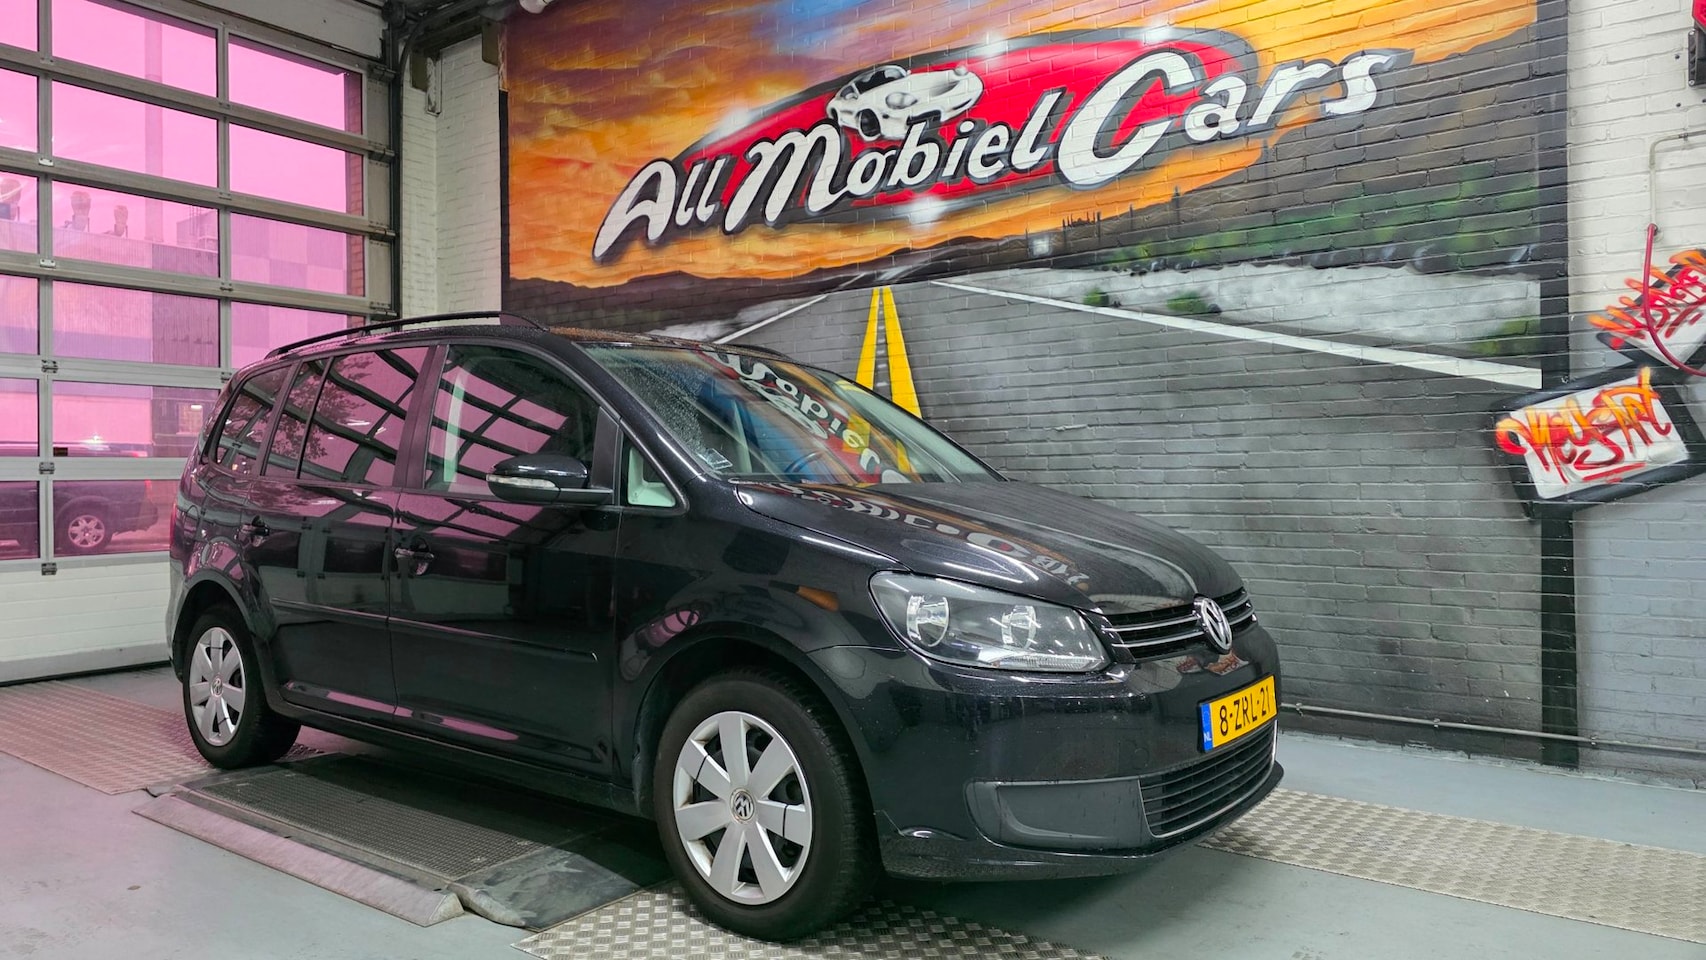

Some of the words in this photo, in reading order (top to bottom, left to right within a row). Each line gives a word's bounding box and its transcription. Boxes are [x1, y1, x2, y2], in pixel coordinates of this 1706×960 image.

[590, 156, 718, 260] All
[723, 90, 1062, 233] Mobiel
[1056, 50, 1402, 187] Cars
[1203, 731, 1213, 743] NL
[1219, 685, 1271, 737] 8-ZRL-21
